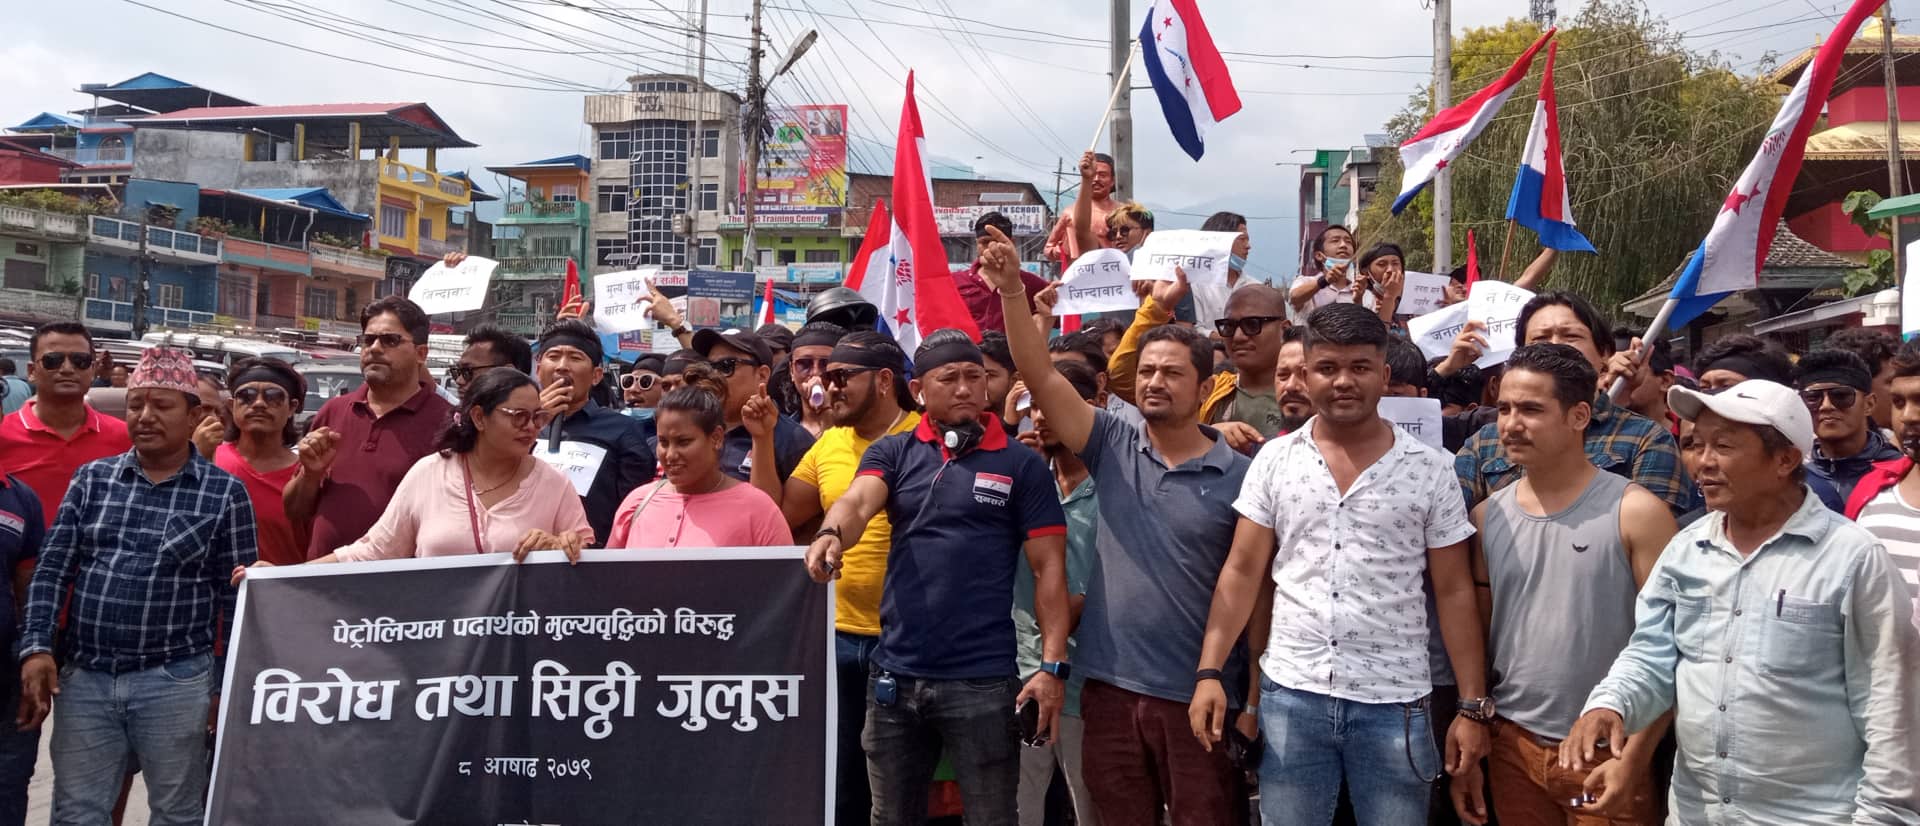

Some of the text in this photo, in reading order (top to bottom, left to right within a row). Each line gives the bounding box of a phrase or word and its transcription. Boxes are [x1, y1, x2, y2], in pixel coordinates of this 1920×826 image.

[1010, 206, 1041, 214] SCHOOL
[763, 215, 794, 224] Training
[796, 215, 821, 223] Centre
[1101, 260, 1121, 272] दल
[1068, 284, 1124, 300] जिन्दावाद
[332, 616, 446, 649] पेट्रोलियम
[452, 609, 541, 637] पदार्थको
[544, 607, 668, 642] मुल्यवृद्धिको
[250, 667, 401, 725] विरोध
[414, 674, 519, 721] तथा
[656, 674, 805, 732] जुलुस
[458, 757, 592, 780] ८ आषाढ २०७९
